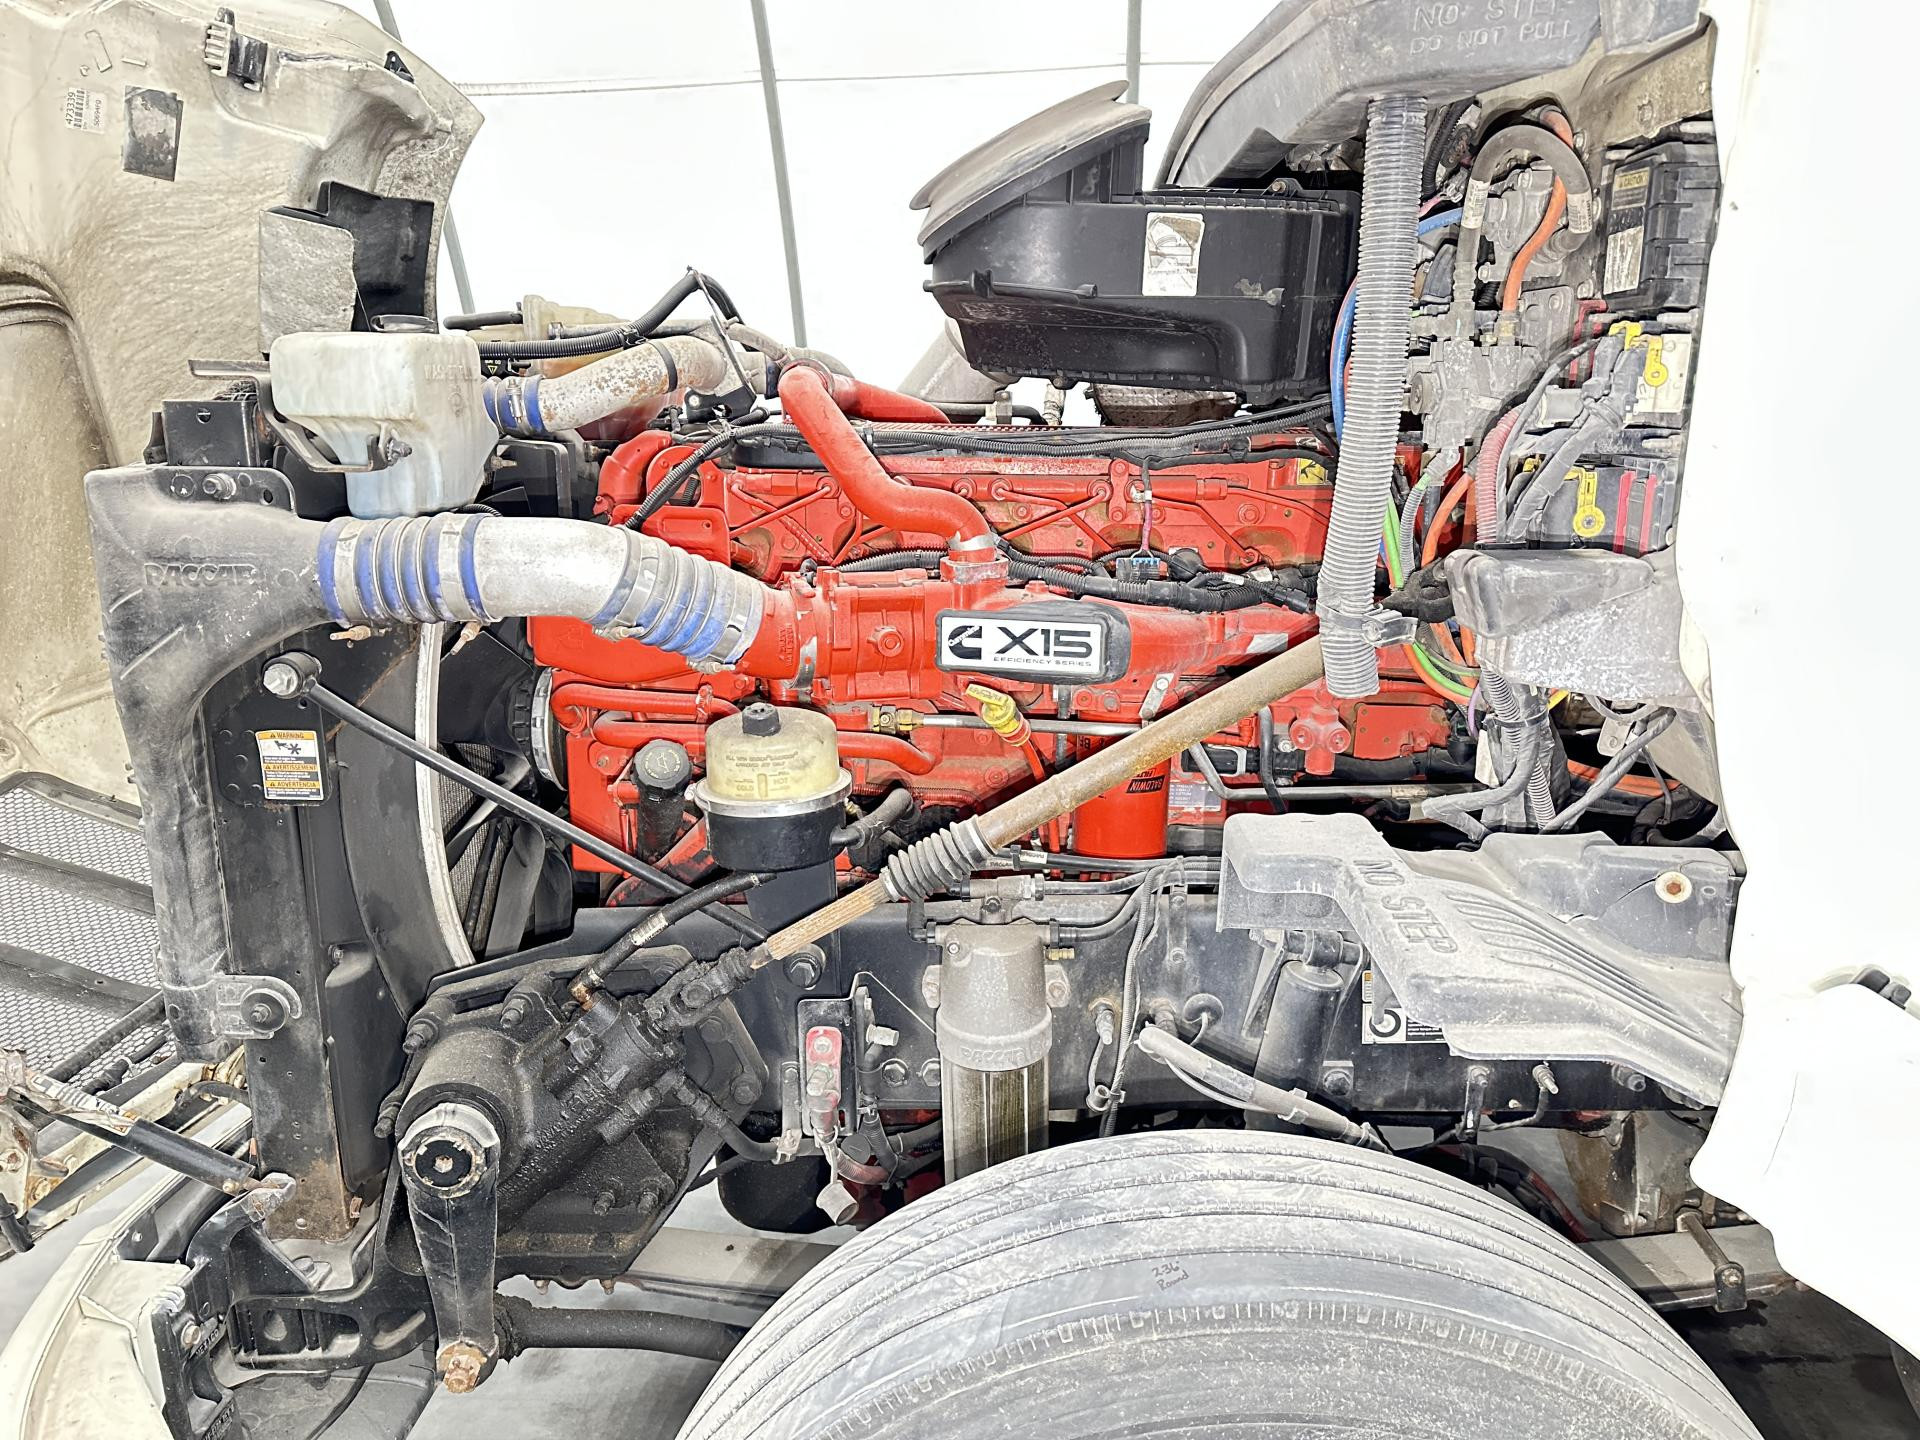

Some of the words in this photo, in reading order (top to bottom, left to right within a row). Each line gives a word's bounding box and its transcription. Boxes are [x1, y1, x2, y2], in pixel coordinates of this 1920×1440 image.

[1413, 3, 1460, 31] NO
[1410, 35, 1442, 55] DO
[1457, 26, 1507, 49] NOT
[1520, 20, 1578, 41] PULL
[65, 91, 76, 125] 473339
[143, 562, 258, 587] PACCAR
[995, 626, 1093, 659] X15
[993, 656, 1052, 665] EFFICIENCY
[1054, 658, 1092, 667] SERIES
[773, 777, 789, 785] HOT
[1129, 778, 1163, 792] BALDWIN
[1353, 859, 1405, 886] NO
[1381, 896, 1459, 954] STEP
[1156, 1269, 1190, 1291] Round
